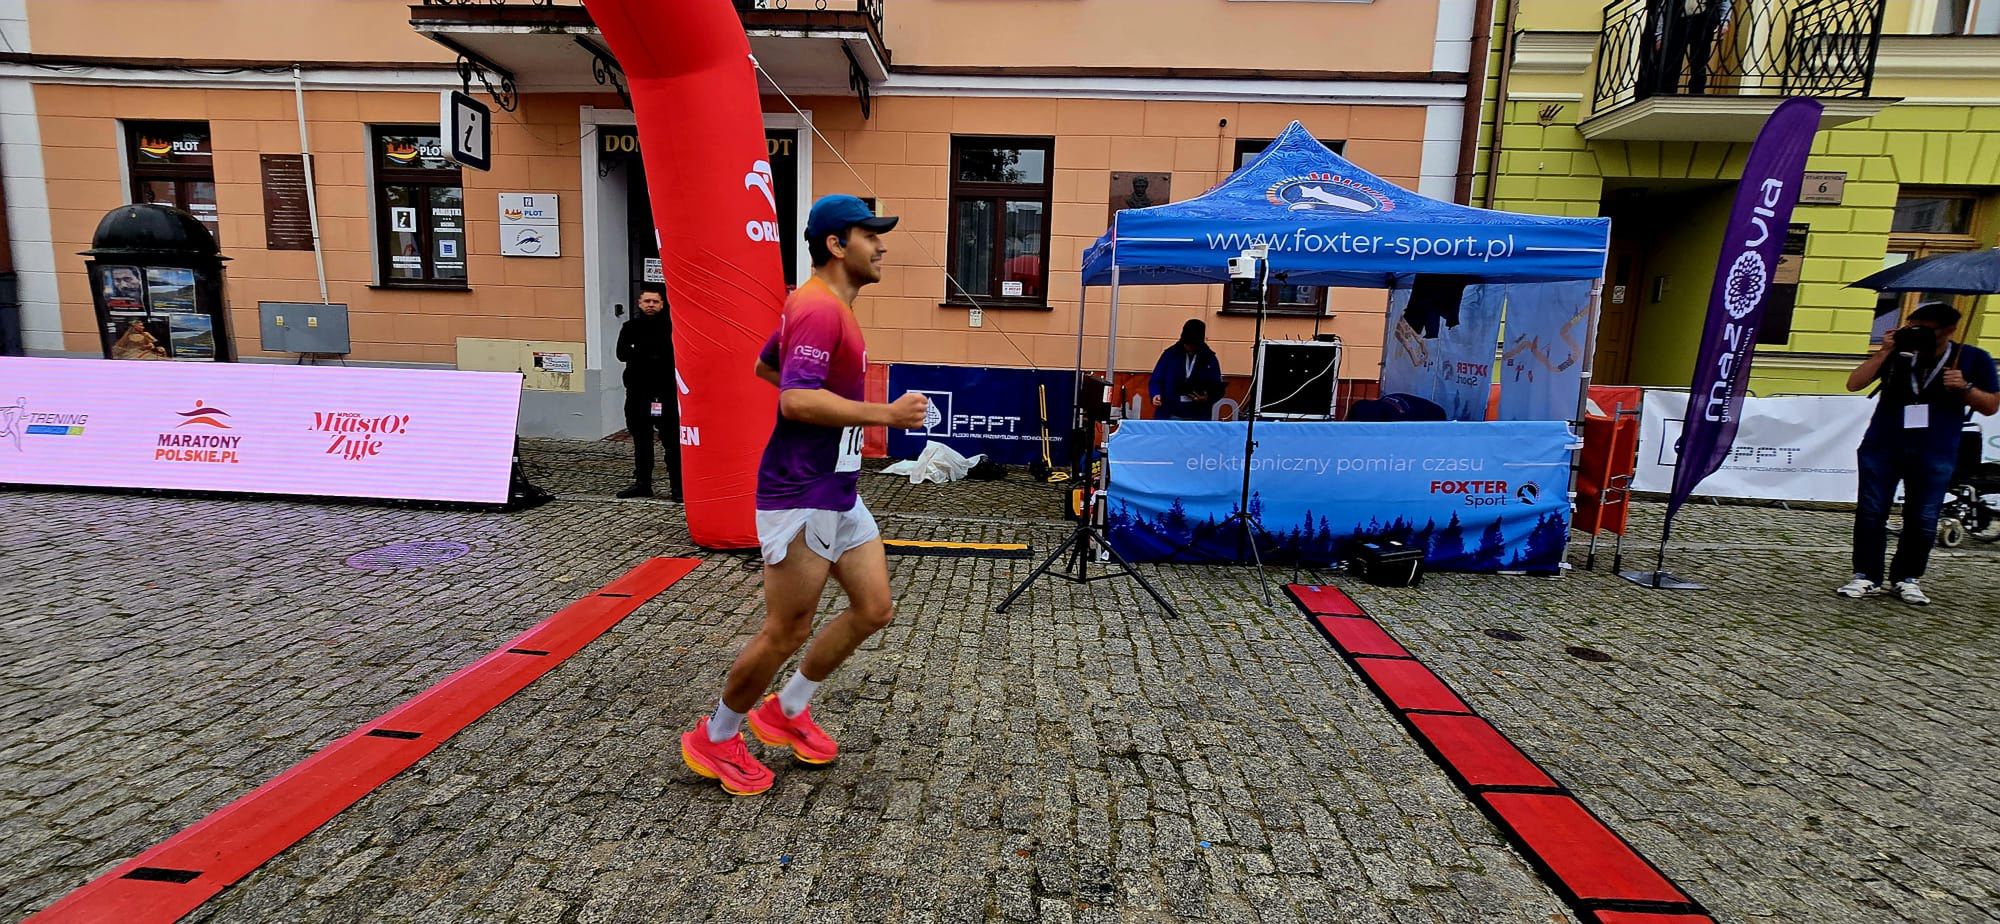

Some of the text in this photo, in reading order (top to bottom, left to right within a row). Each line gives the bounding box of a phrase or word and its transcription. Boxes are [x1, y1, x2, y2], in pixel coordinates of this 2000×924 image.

[172, 141, 199, 151] PLOT
[419, 146, 444, 157] PLO
[1818, 181, 1829, 194] 6
[745, 220, 781, 242] ORL
[1206, 227, 1515, 263] www.foxter-sport.pl
[29, 412, 89, 425] TRENING
[952, 414, 1021, 433] PPPT
[157, 433, 242, 449] MARATONY
[154, 448, 240, 464] POLSKIE.PL
[1185, 453, 1485, 476] elektroniczny pomiar czasu
[1429, 480, 1508, 494] FOXTER
[1464, 495, 1507, 509] Sport
